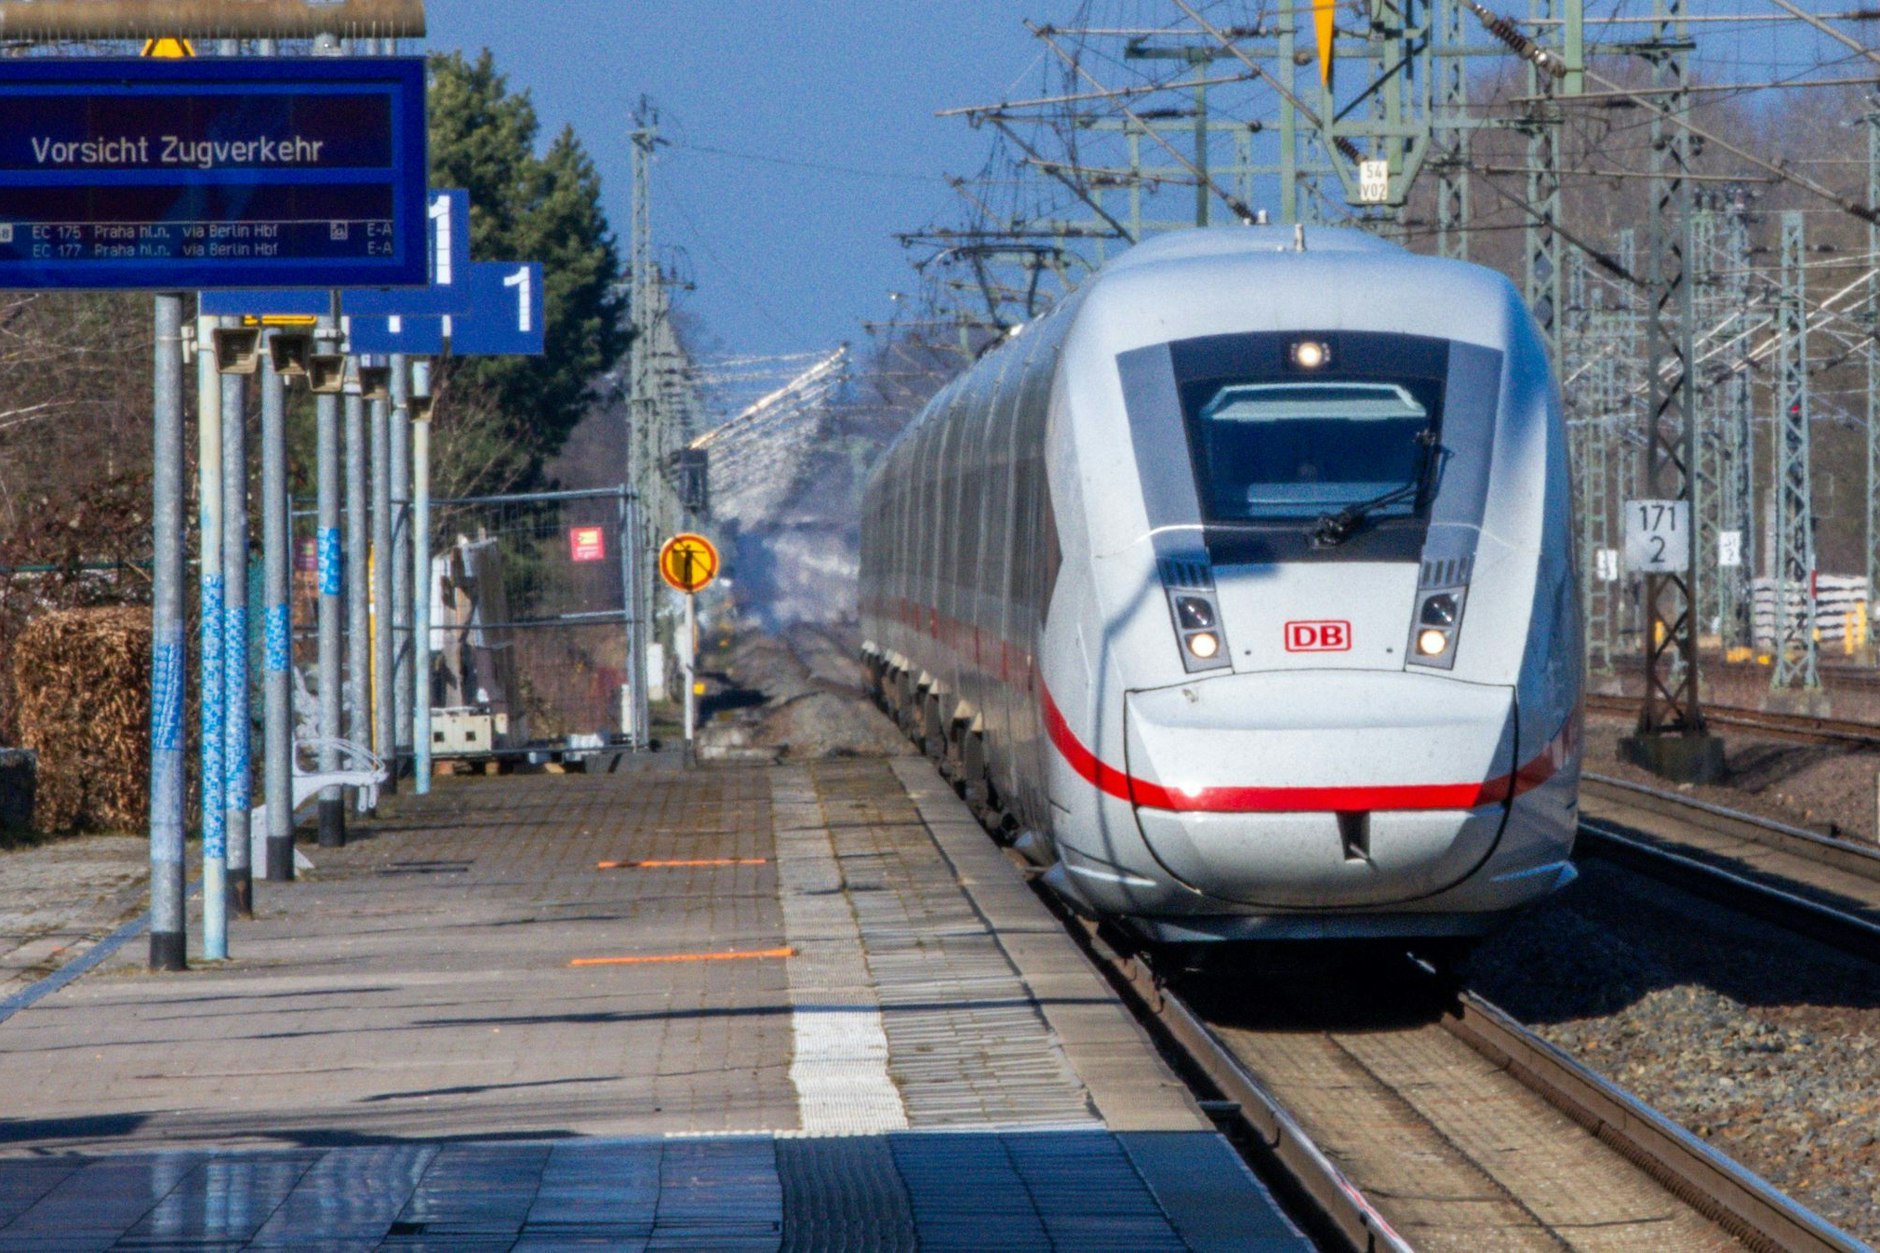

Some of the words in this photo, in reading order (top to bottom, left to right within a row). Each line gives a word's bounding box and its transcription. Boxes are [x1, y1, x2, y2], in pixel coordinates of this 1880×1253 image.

[31, 136, 149, 163] Vorsicht
[161, 136, 324, 169] Zugverkehr
[32, 225, 51, 240] EC
[57, 225, 82, 240] 175
[94, 225, 135, 239] Praha
[182, 224, 205, 238] via
[209, 223, 249, 238] Berlin
[254, 223, 279, 238] Hbf
[366, 222, 393, 237] E-A
[429, 195, 452, 285] 1
[32, 244, 51, 258] EC
[57, 244, 82, 257] 177
[94, 243, 135, 257] Praha
[182, 243, 205, 256] via
[209, 242, 249, 256] Berlin
[254, 242, 279, 256] Hbf
[366, 241, 393, 255] E-A
[503, 265, 531, 333] 1
[1639, 505, 1677, 532] 171
[1649, 535, 1667, 563] 2
[1292, 624, 1345, 648] DB
